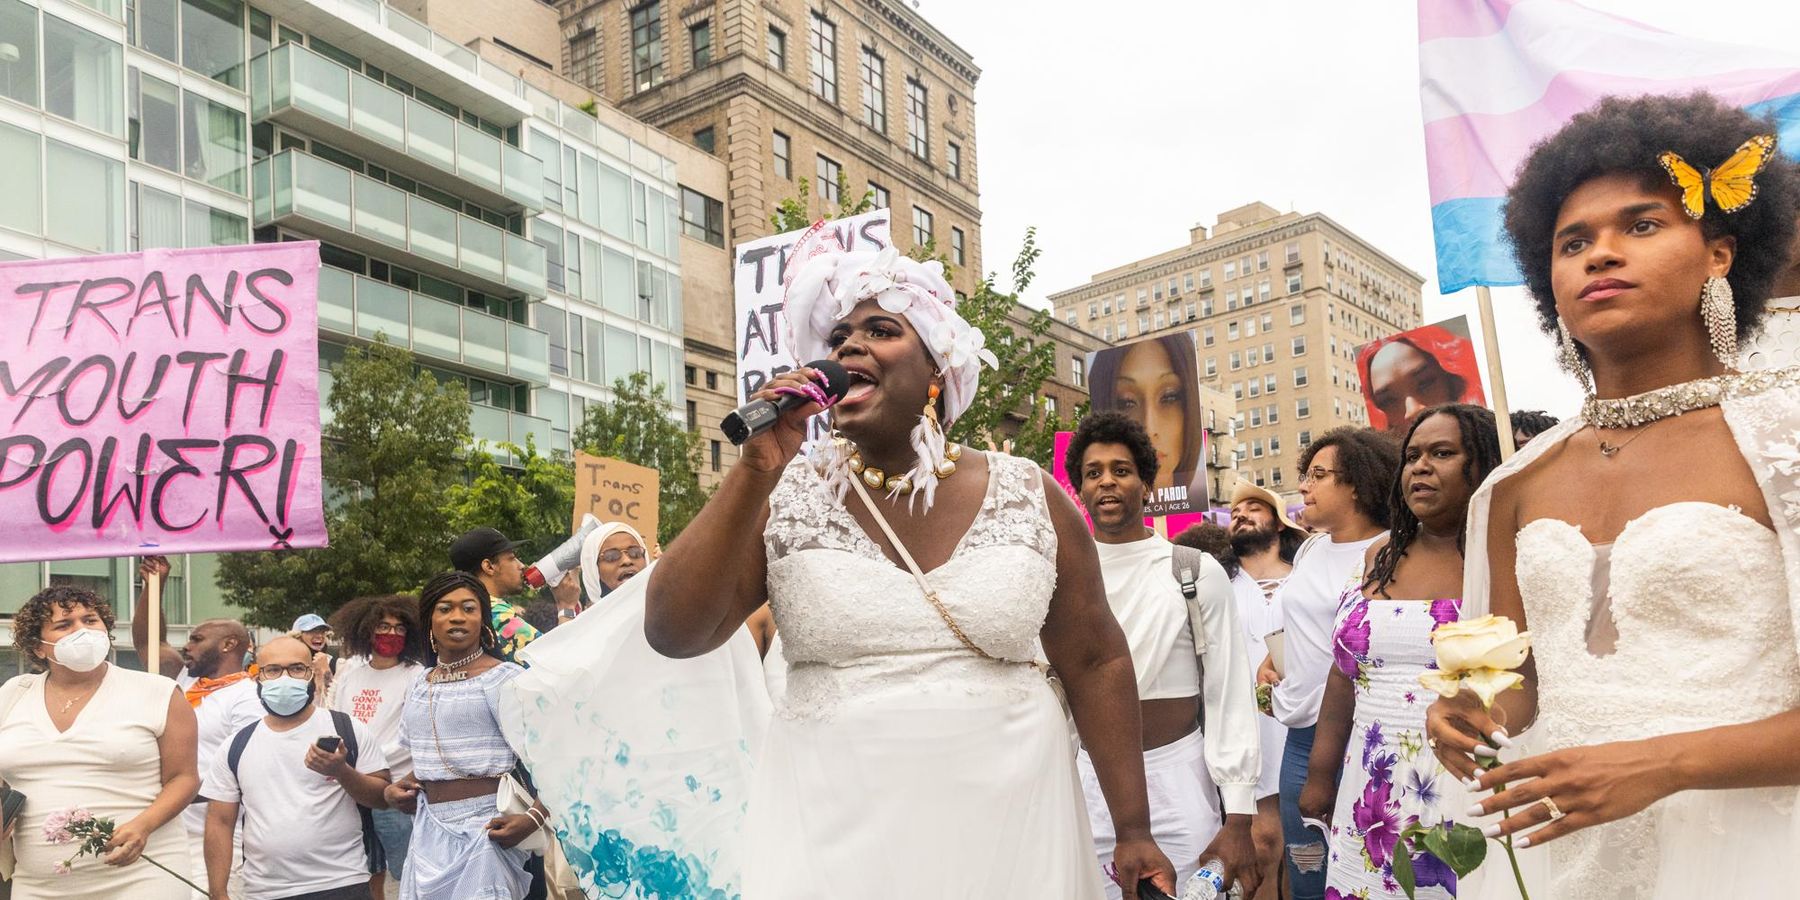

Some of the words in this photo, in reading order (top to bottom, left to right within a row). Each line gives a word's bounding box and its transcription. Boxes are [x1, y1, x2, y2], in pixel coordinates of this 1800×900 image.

[15, 268, 294, 346] TRANS
[0, 348, 285, 429] YOUTH
[584, 463, 644, 495] Trans
[0, 433, 299, 549] POWER!
[1157, 485, 1188, 502] PARDO
[590, 493, 641, 520] POC
[1154, 504, 1164, 512] CA
[1169, 503, 1181, 511] AGE
[1181, 502, 1190, 510] 26
[361, 689, 381, 697] NOT
[352, 710, 377, 718] THAT
[354, 702, 378, 711] TAKE
